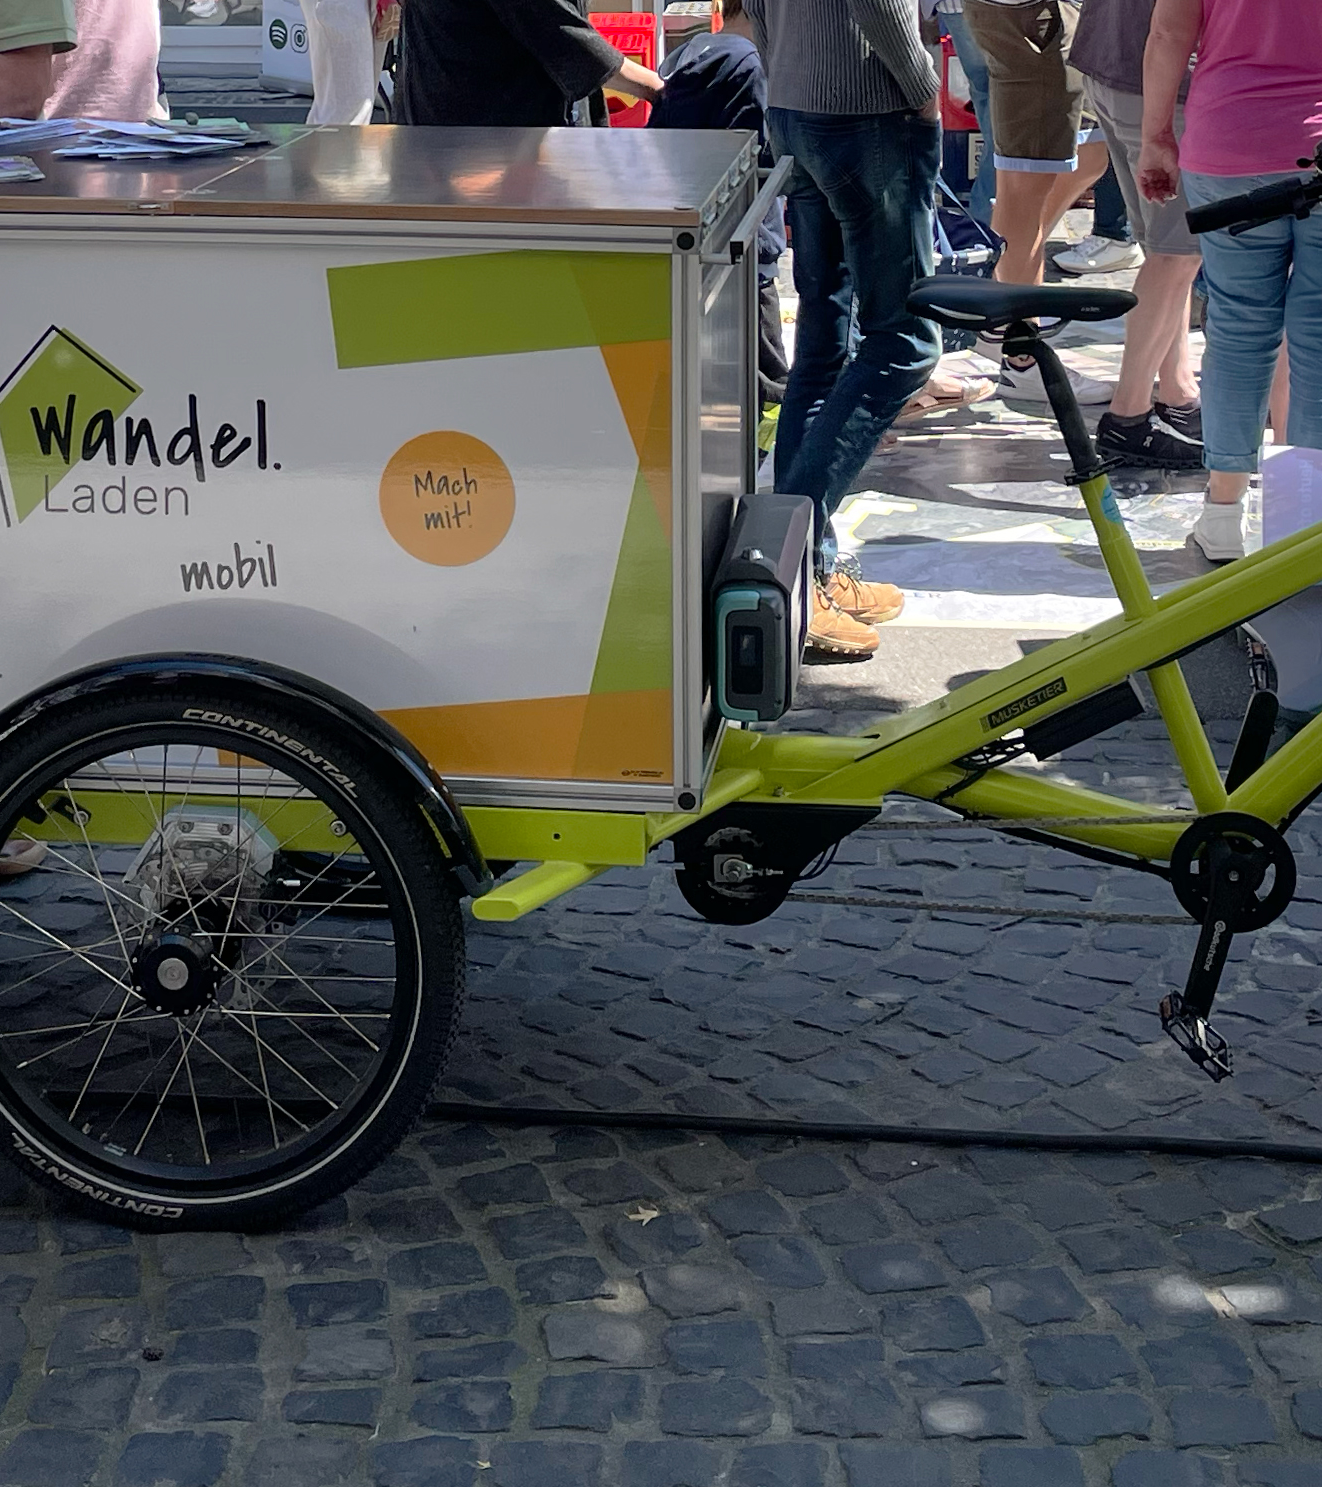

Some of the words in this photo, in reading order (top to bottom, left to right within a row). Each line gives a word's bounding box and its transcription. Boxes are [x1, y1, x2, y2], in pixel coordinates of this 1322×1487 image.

[44, 474, 190, 516] Laden
[413, 468, 478, 497] Mach
[424, 500, 473, 531] mit!
[180, 540, 279, 593] mobil
[990, 680, 1064, 725] MUSKETIER
[181, 708, 359, 799] CONTINENTAL
[11, 1132, 184, 1219] CONTINENTAL
